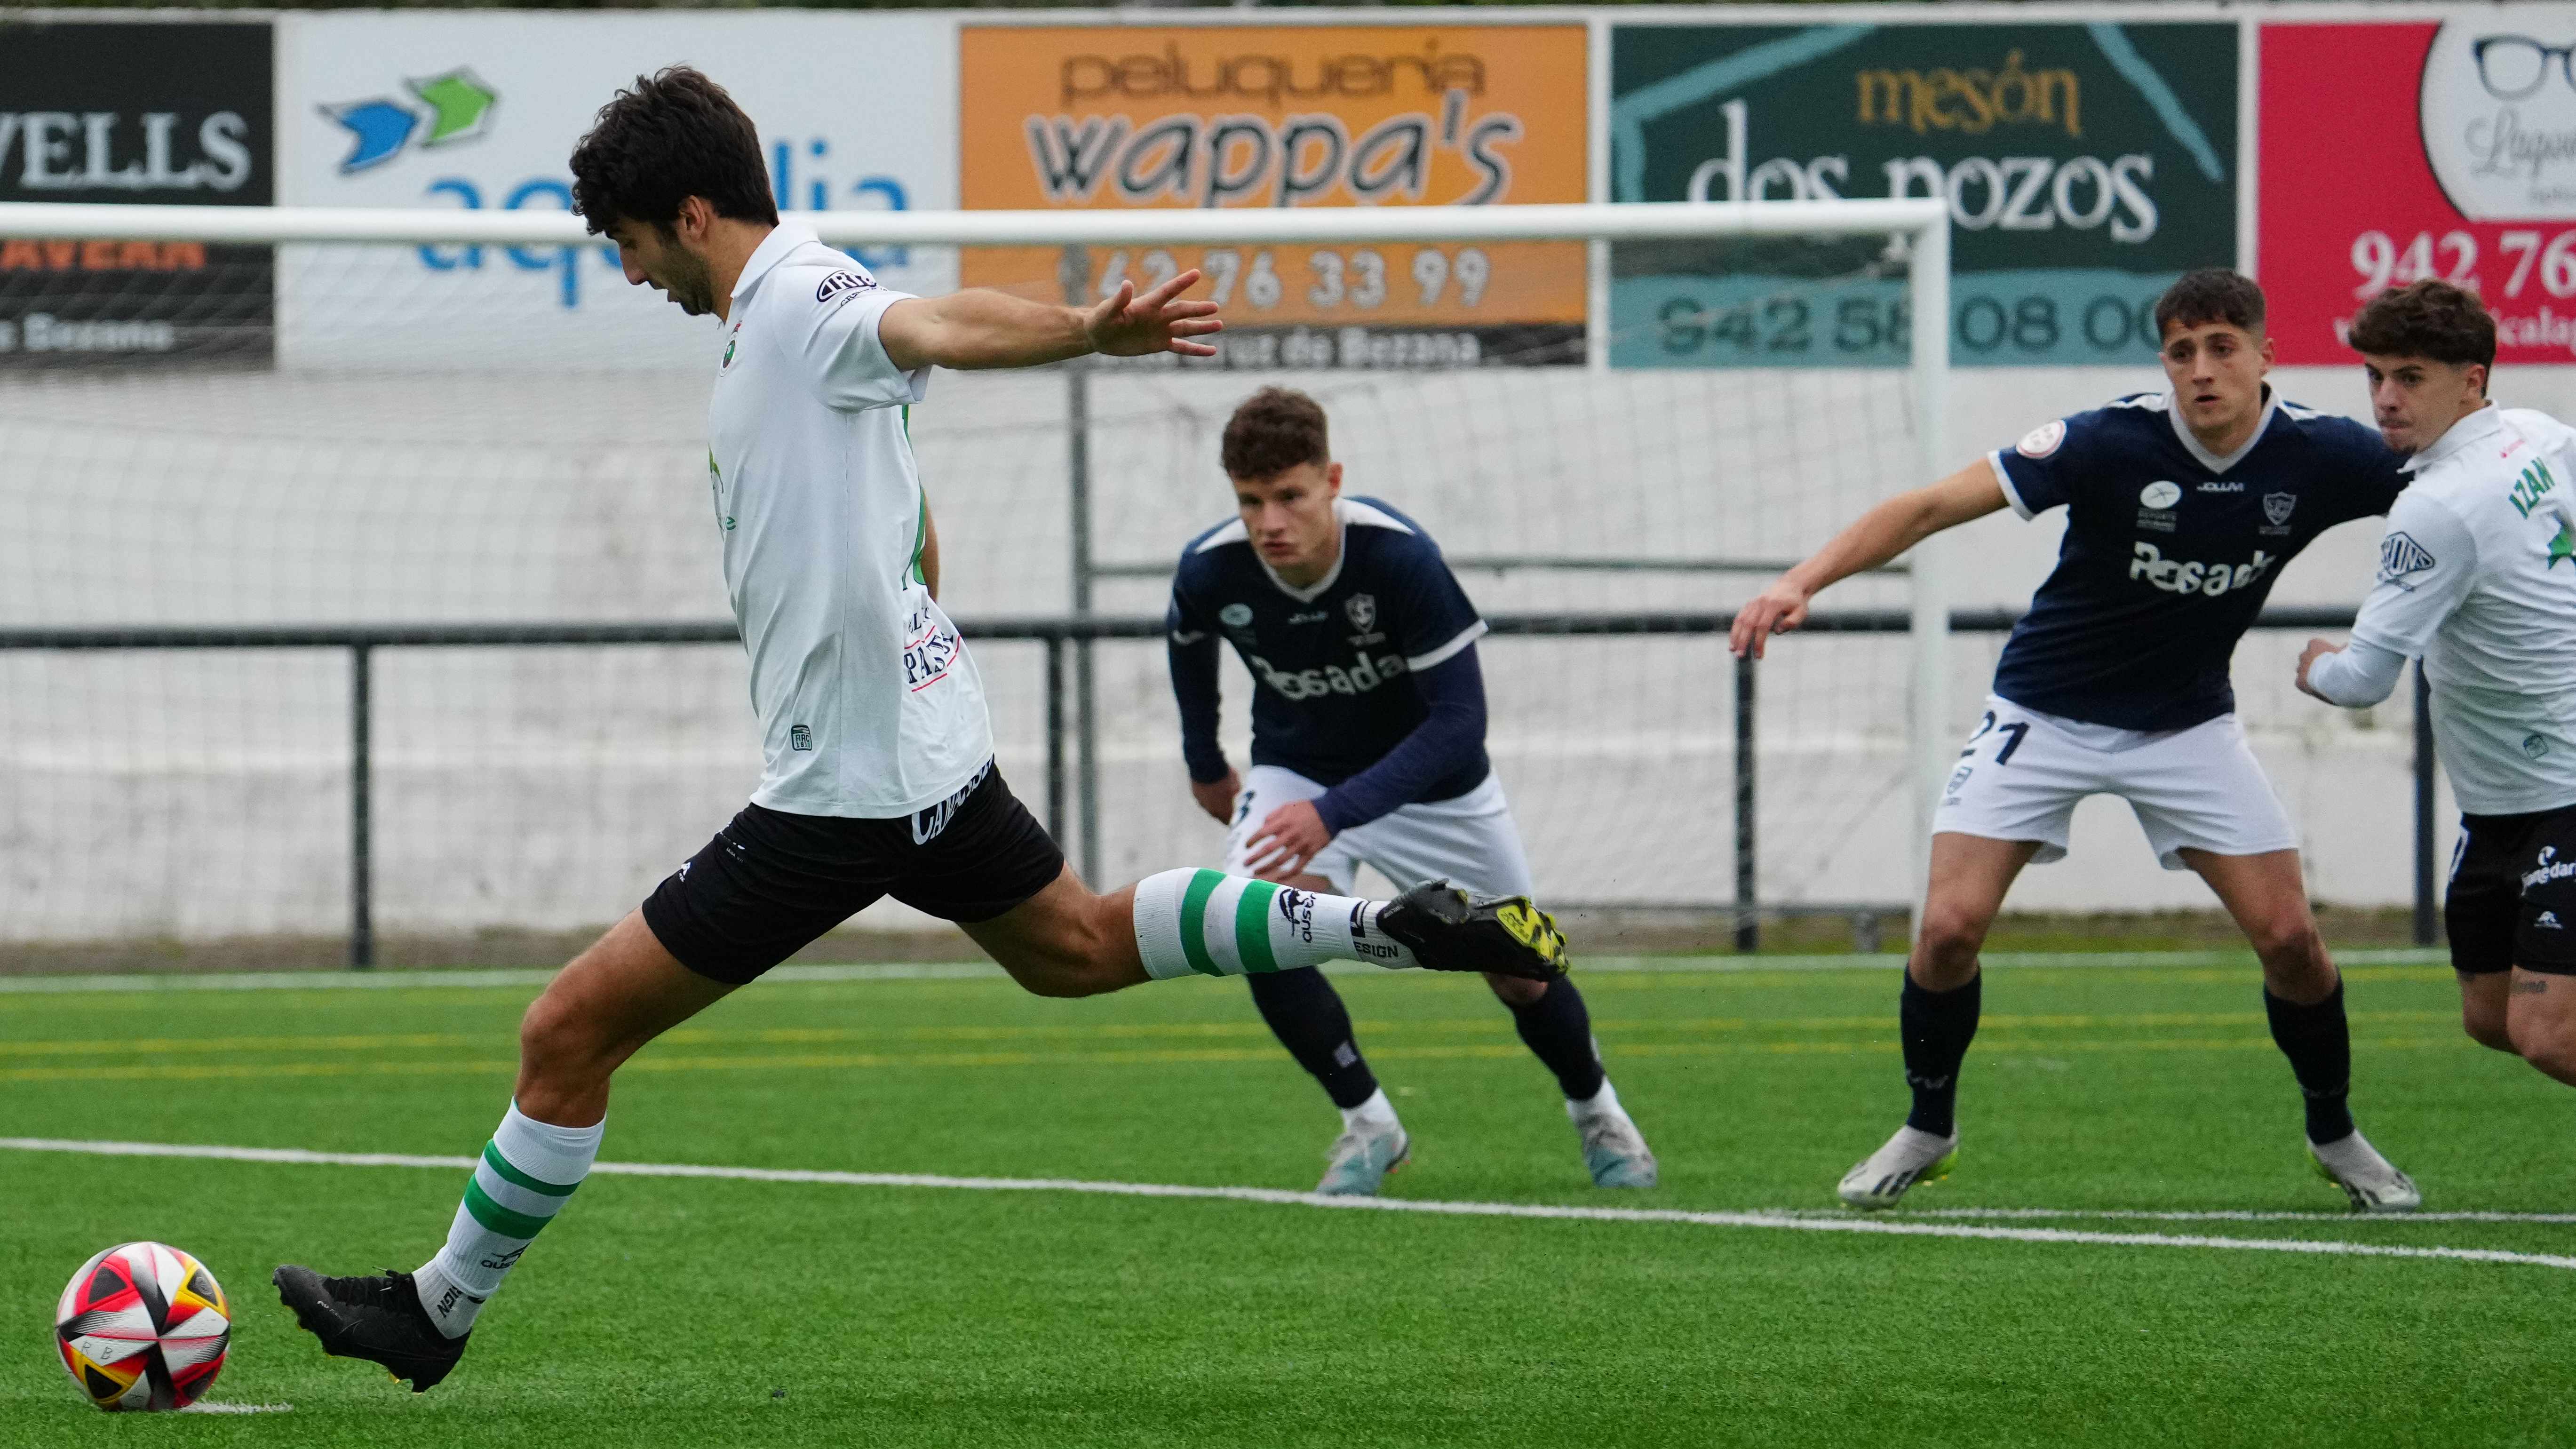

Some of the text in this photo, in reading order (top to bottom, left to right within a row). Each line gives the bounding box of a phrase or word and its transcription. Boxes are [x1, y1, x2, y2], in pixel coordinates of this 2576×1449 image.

[1856, 47, 2083, 137] mesón
[1024, 88, 1522, 208] wappa's
[418, 136, 909, 309] aqlia
[1201, 250, 1283, 310] 76
[1308, 249, 1387, 310] 33
[1413, 247, 1491, 308] 99
[1956, 293, 2061, 354] 08
